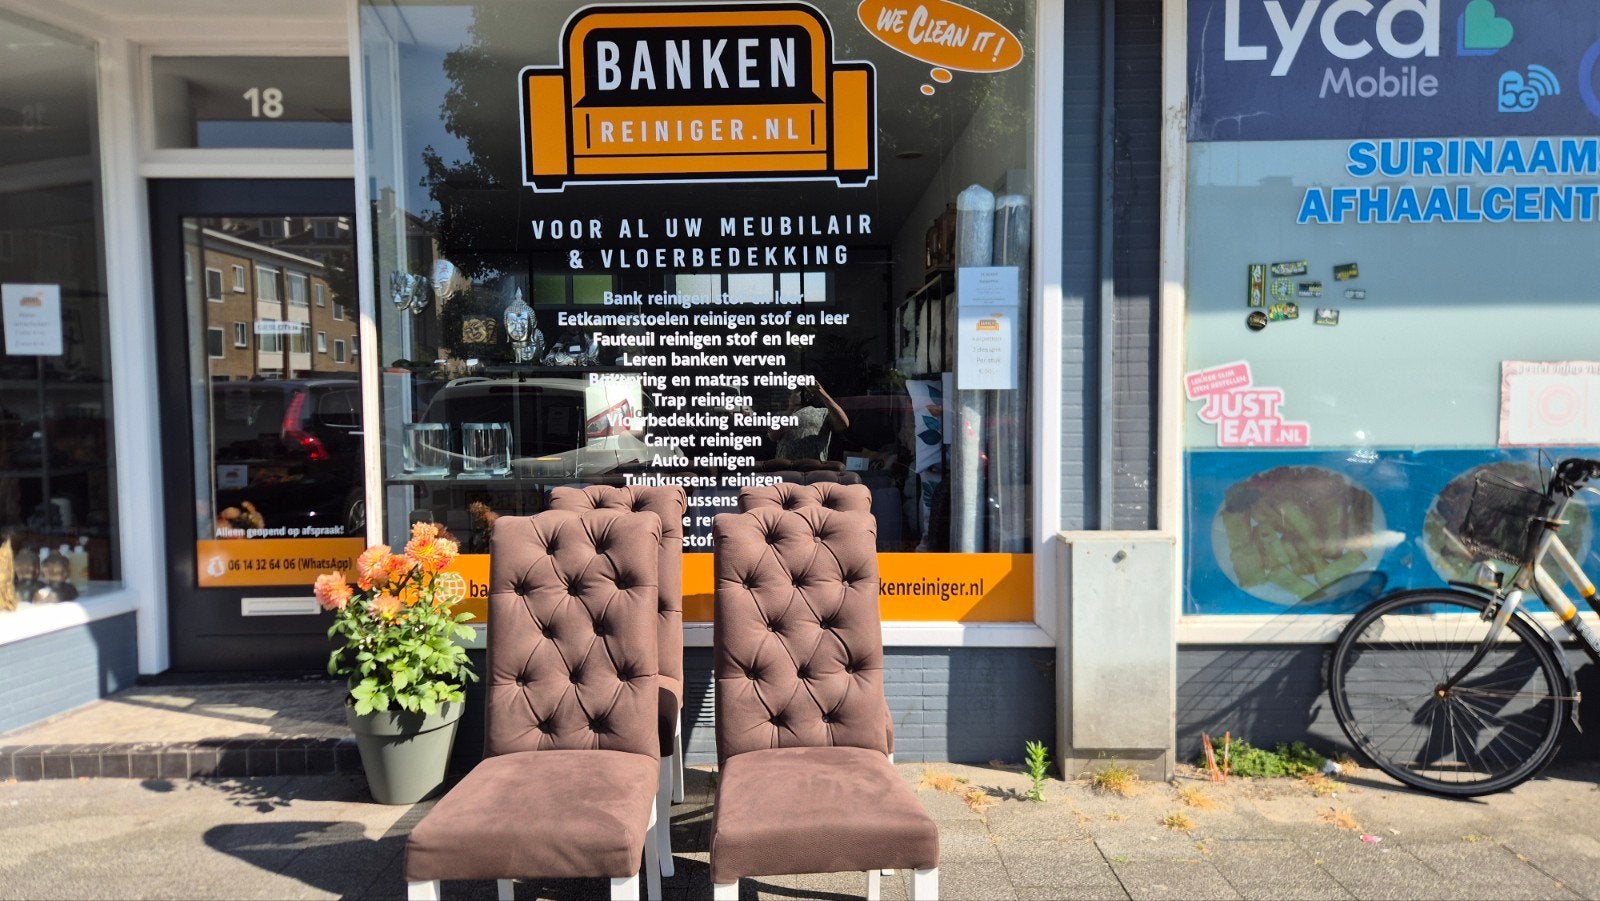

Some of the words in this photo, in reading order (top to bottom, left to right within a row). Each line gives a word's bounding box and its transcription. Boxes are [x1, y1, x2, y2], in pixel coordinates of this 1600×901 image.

[876, 6, 908, 34] WE
[908, 4, 971, 48] CLEAN
[1225, 0, 1440, 77] Lyca
[598, 37, 796, 91] BANKEN
[1319, 66, 1439, 98] Mobile
[1501, 80, 1535, 108] 5G
[243, 87, 283, 118] 18
[601, 118, 799, 143] REINIGER.NL
[1346, 137, 1600, 177] SURINAAM
[1297, 184, 1600, 224] AFHAALCENT
[531, 219, 602, 239] VOOR
[619, 218, 649, 239] AL
[665, 217, 702, 238] UW
[720, 214, 872, 237] MEUBILAIR
[569, 250, 584, 268] &
[601, 244, 848, 269] VLOERBEDEKKING
[603, 291, 643, 305] Bank
[648, 291, 710, 308] reinigen
[558, 311, 689, 326] Eetkamerstoelen
[694, 311, 755, 329] reinigen
[760, 311, 792, 326] stof
[797, 314, 815, 325] en
[820, 311, 850, 325] leer
[592, 331, 655, 346] Fauteuil
[660, 331, 721, 350] reinigen
[726, 331, 758, 346] stof
[763, 334, 782, 345] en
[786, 331, 816, 345] leer
[623, 353, 667, 367] Leren
[671, 352, 728, 367] banken
[733, 354, 786, 366] verven
[589, 372, 667, 391] Bring
[672, 376, 690, 386] en
[696, 373, 748, 386] matras
[753, 372, 816, 389] reinigen
[652, 393, 686, 410] Trap
[692, 392, 753, 410] reinigen
[1206, 393, 1278, 418] JUST
[607, 412, 729, 430] Vlorbedekking
[733, 412, 799, 430] Reinigen
[1224, 419, 1303, 443] EAT.NL
[644, 433, 696, 450] Carpet
[700, 432, 762, 450] reinigen
[651, 453, 689, 467] Auto
[694, 452, 755, 470] reinigen
[623, 473, 717, 487] Tuinkussens
[722, 472, 783, 487] reinigen
[215, 527, 246, 537] Alleen
[246, 526, 286, 538] geopend
[288, 527, 300, 538] op
[302, 525, 345, 537] afspraak!
[227, 559, 240, 571] 06
[243, 559, 253, 570] 14
[256, 559, 267, 570] 32
[269, 558, 281, 570] 64
[283, 558, 296, 570] 06
[298, 557, 353, 572] (WhatsApp)
[878, 577, 984, 601] kenreiniger.nl
